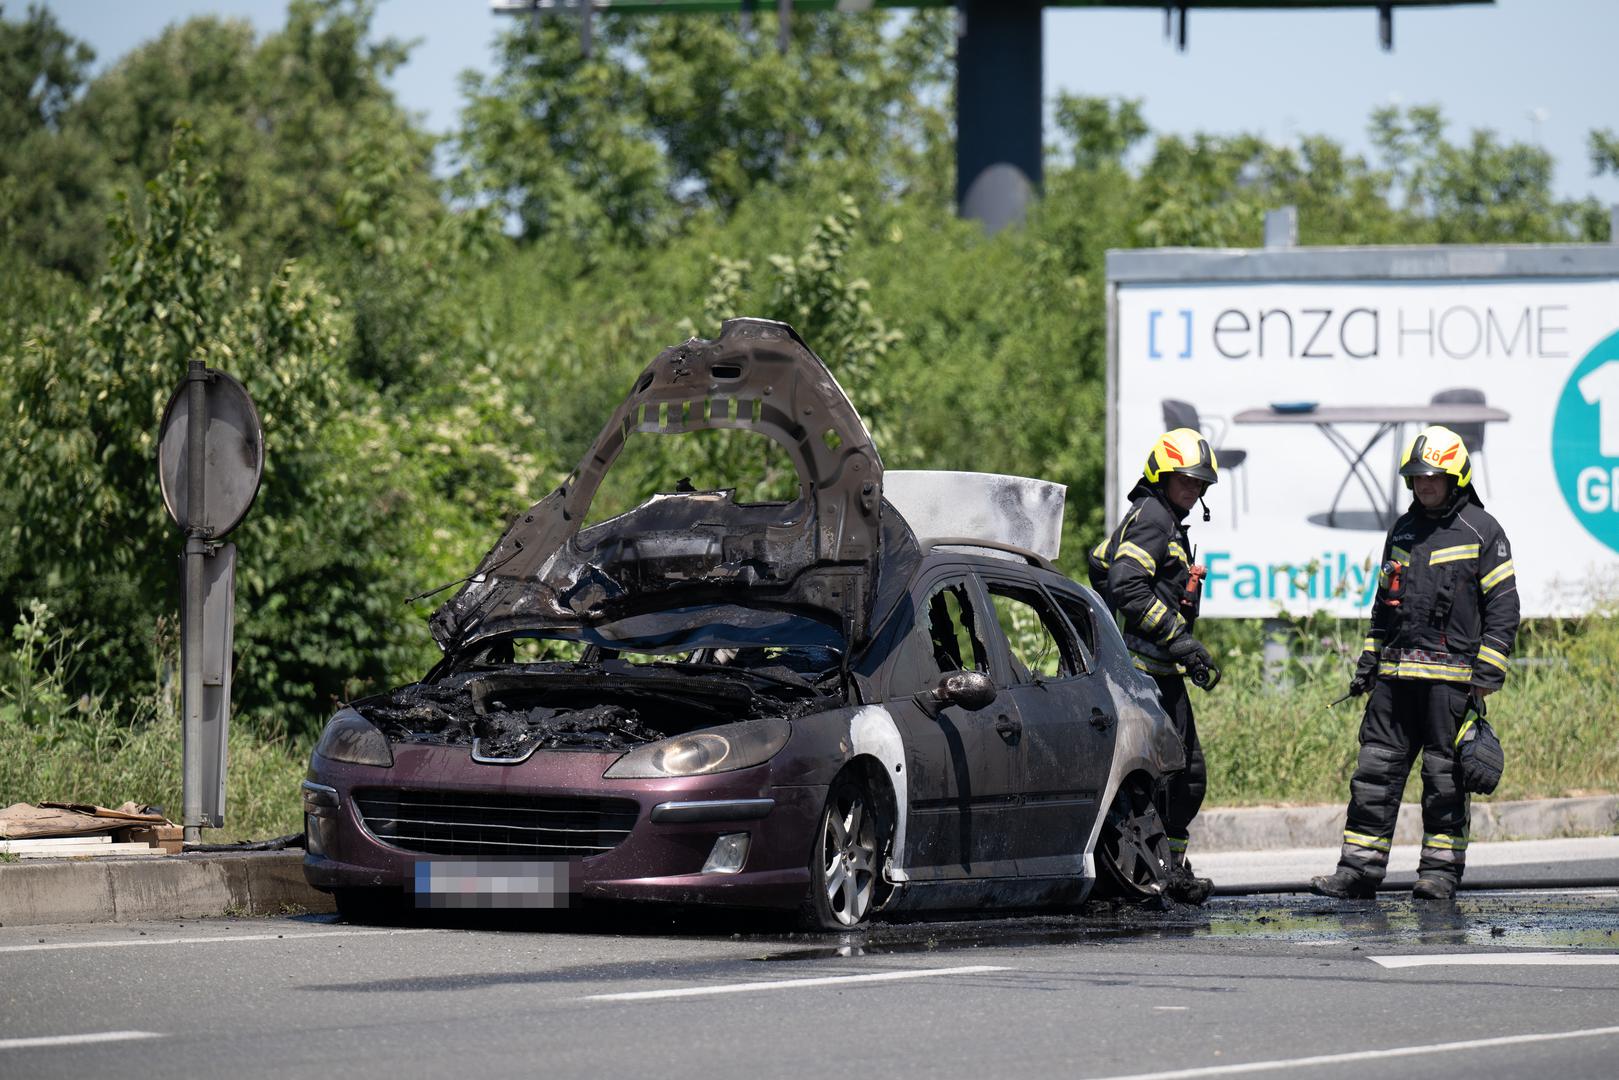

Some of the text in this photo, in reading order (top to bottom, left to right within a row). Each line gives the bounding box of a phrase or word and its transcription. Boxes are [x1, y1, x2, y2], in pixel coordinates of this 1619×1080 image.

[1213, 304, 1569, 360] enza HOME
[1424, 447, 1441, 462] 26
[1577, 465, 1619, 514] G
[1204, 552, 1381, 608] Family
